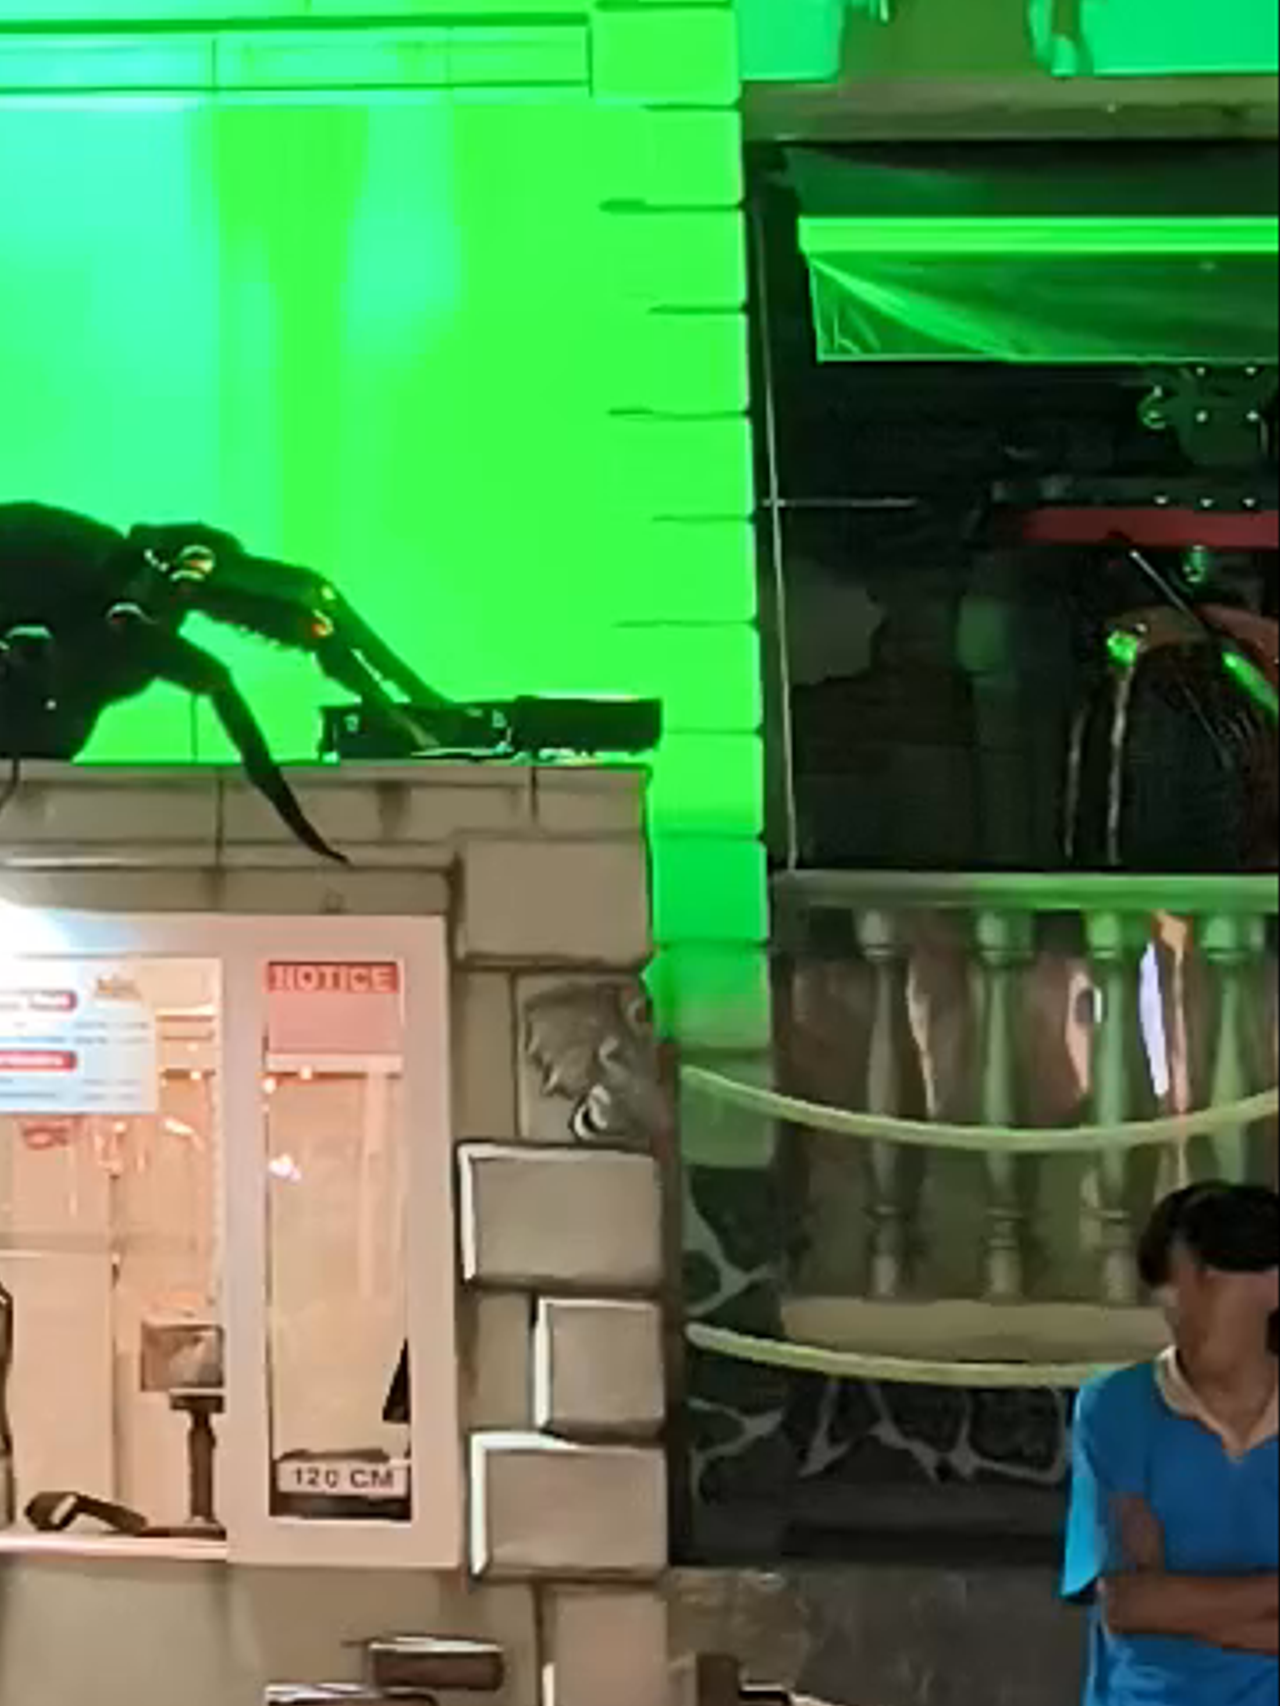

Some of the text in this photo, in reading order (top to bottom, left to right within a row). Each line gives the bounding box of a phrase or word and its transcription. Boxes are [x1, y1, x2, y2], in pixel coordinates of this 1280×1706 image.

[273, 966, 393, 992] NOTICE
[295, 1466, 395, 1489] 120 CM
